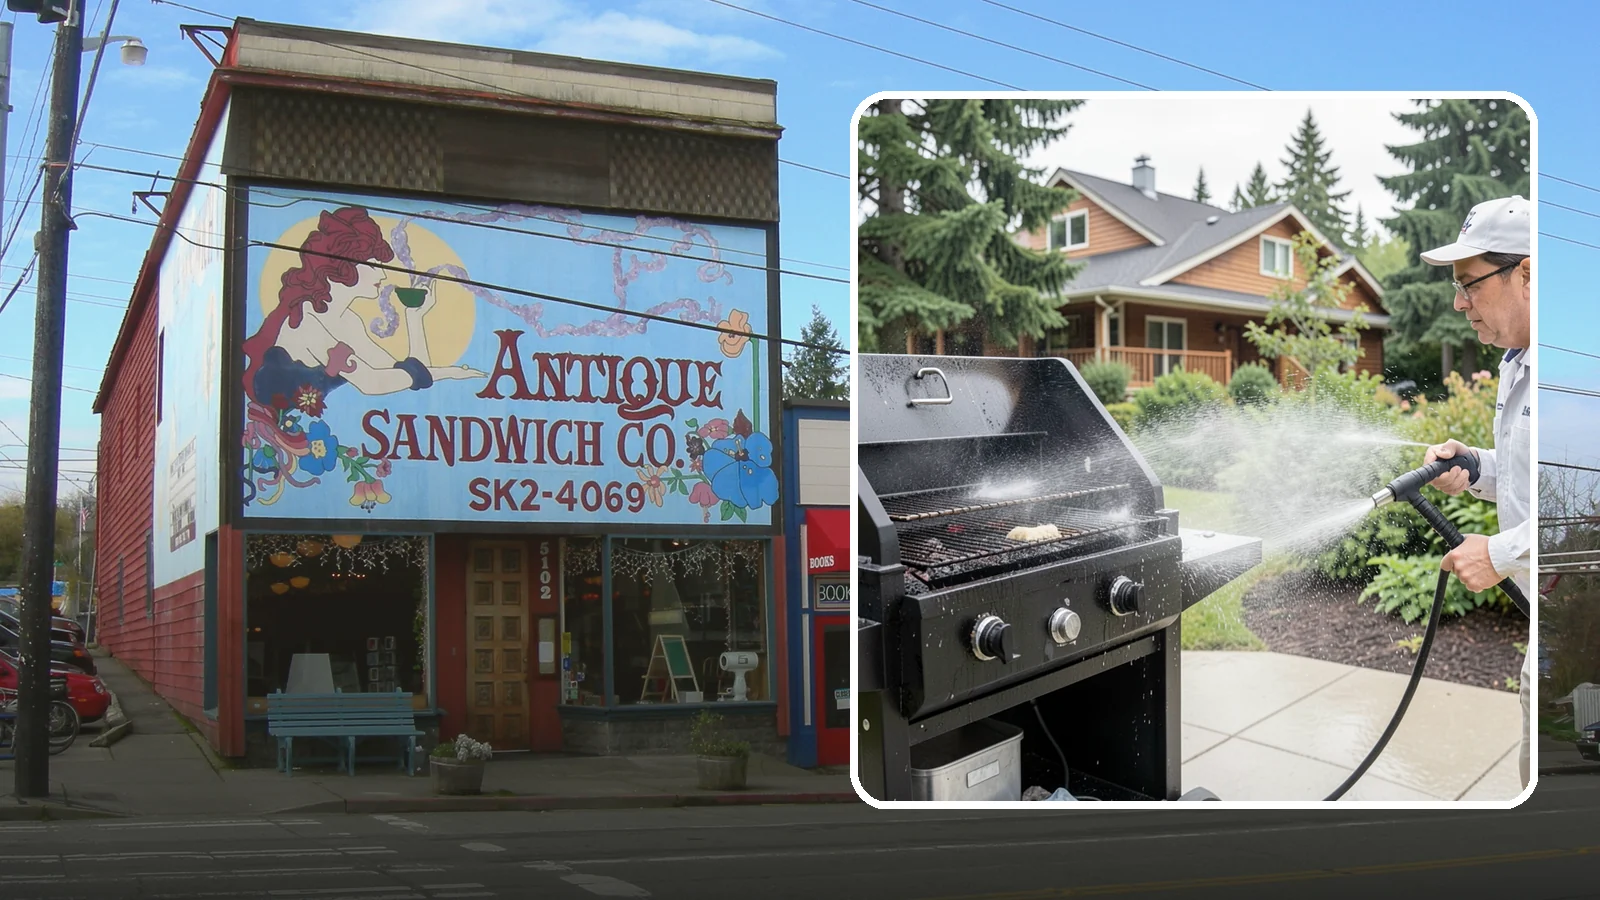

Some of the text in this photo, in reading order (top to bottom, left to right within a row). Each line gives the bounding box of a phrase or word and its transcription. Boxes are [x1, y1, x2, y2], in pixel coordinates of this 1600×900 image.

[476, 329, 724, 421] ANTIQUE
[360, 409, 686, 469] SANDWICH CO.
[468, 478, 646, 513] SK2-4069
[539, 541, 552, 600] 5102
[809, 555, 835, 569] BOOKS
